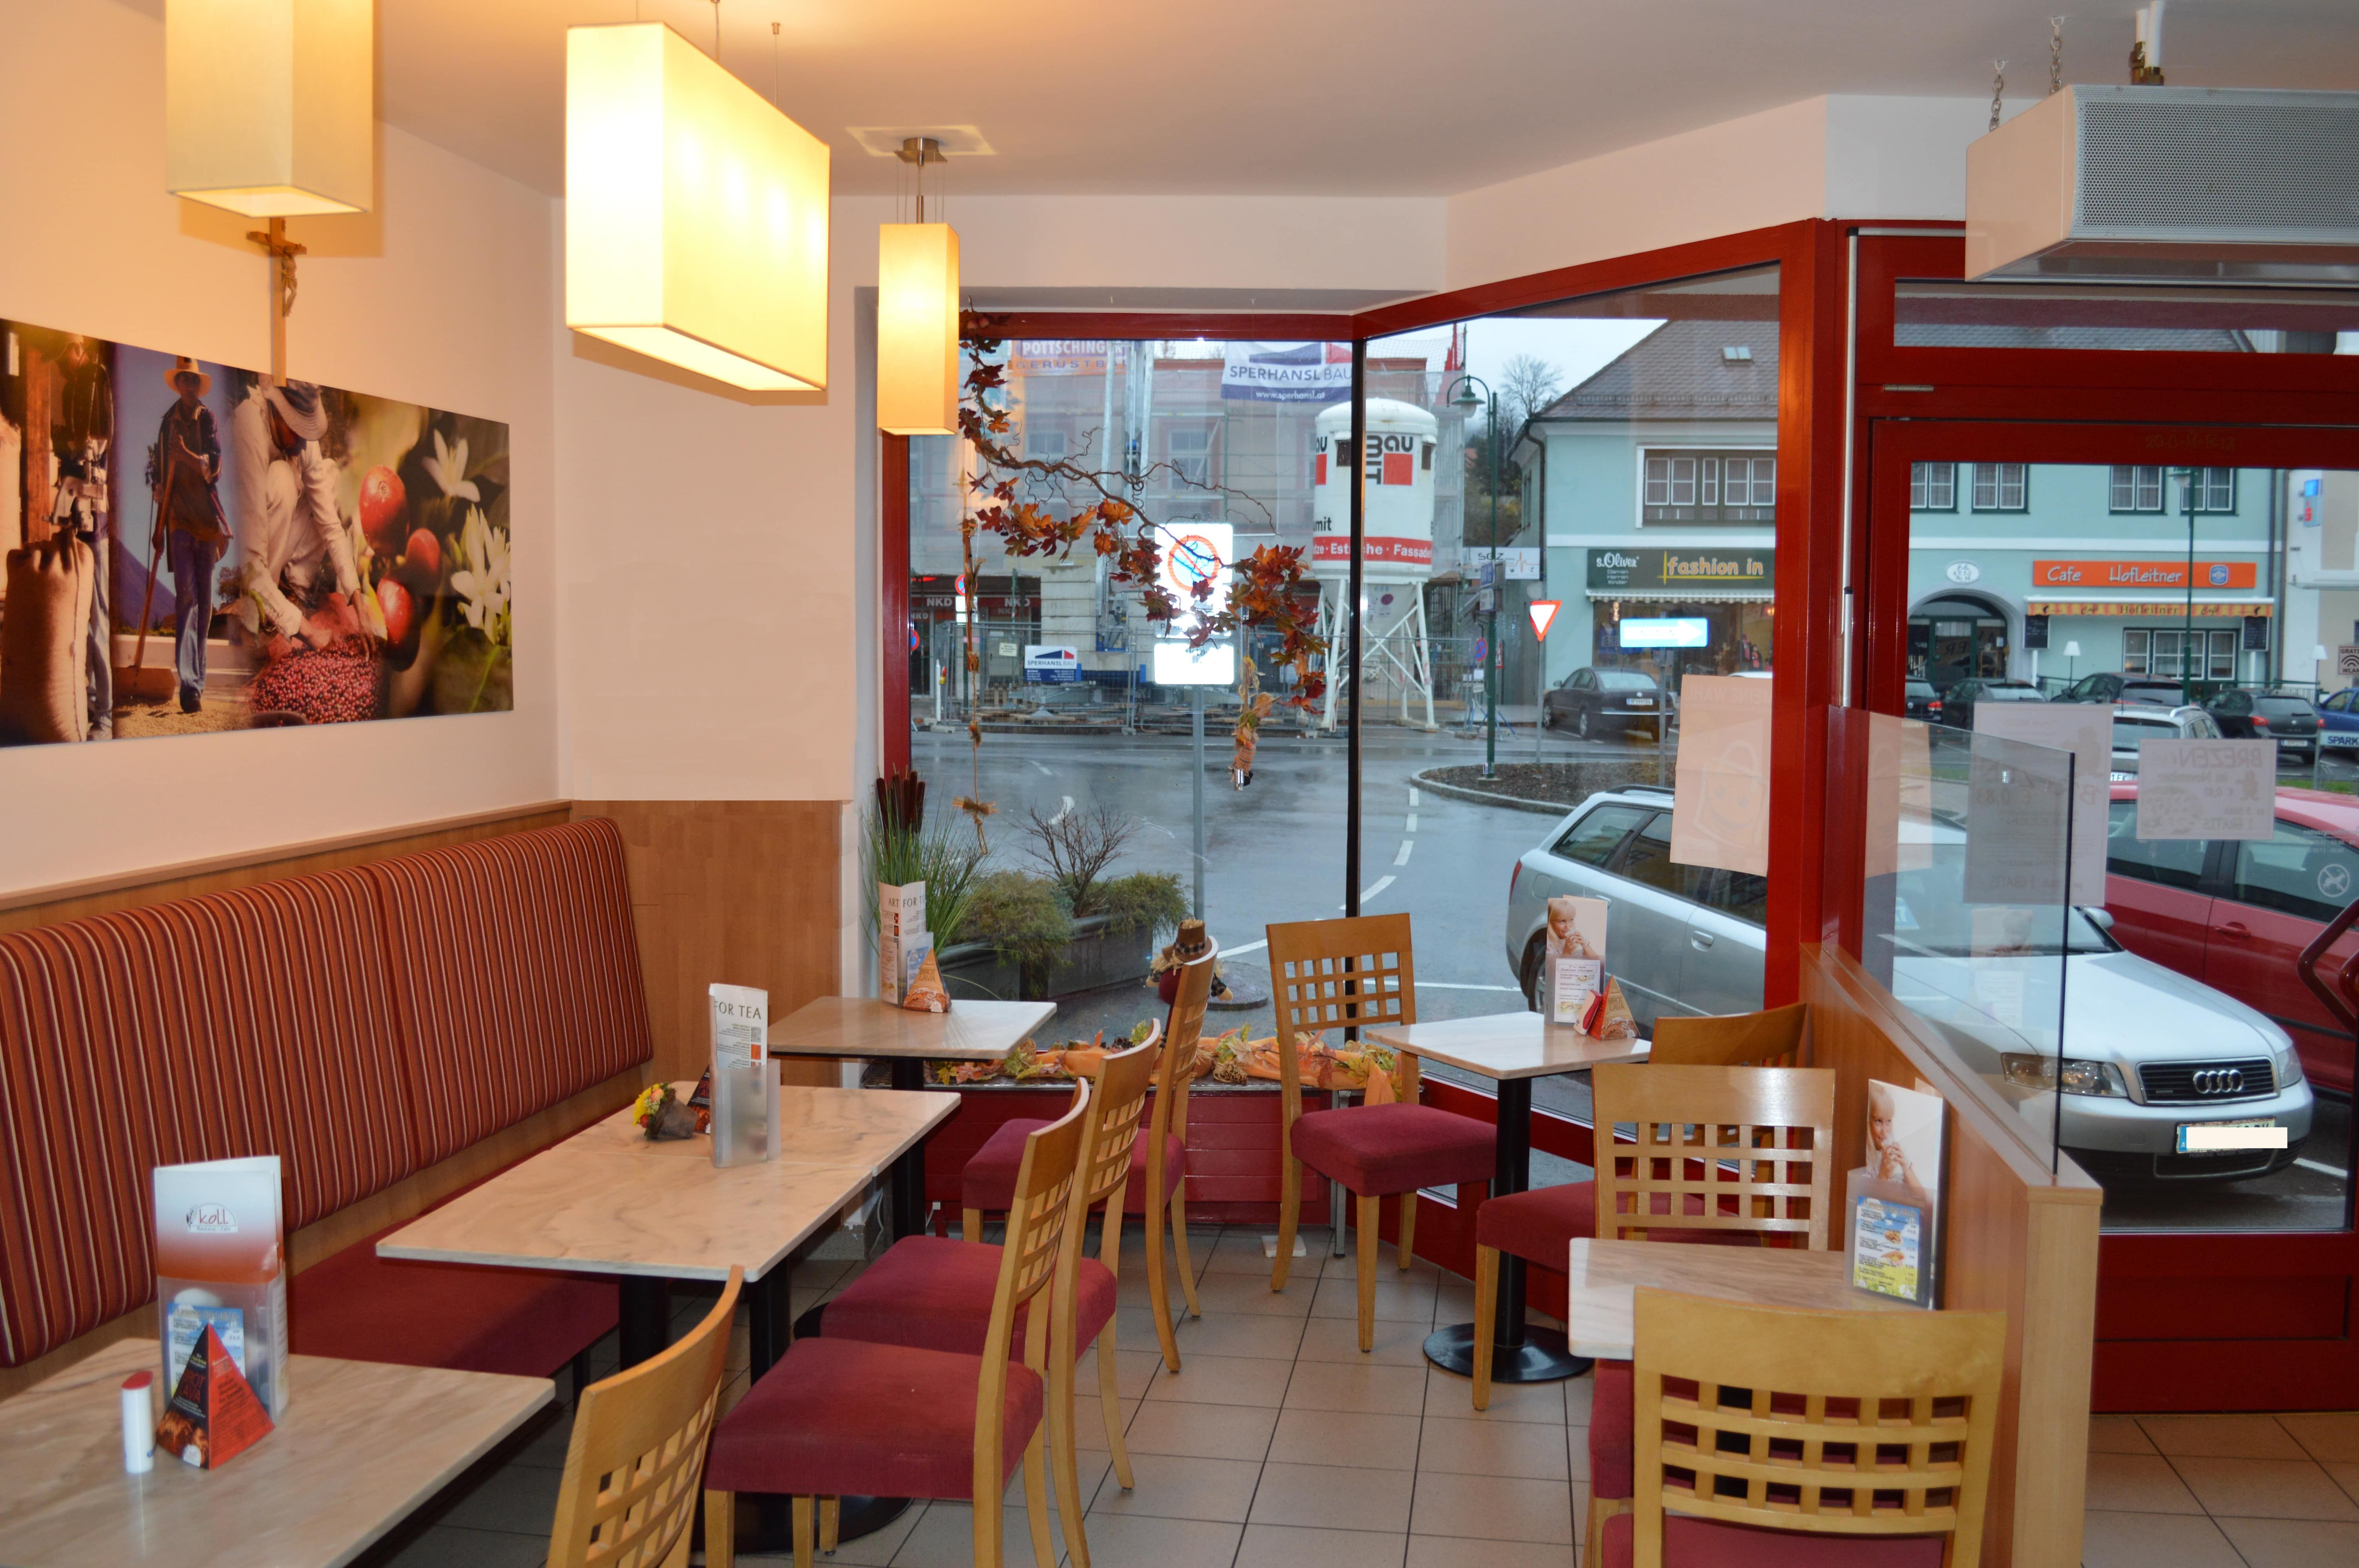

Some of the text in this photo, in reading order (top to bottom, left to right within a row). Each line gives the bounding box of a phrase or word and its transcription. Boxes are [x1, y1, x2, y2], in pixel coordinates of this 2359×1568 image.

[1230, 366, 1352, 381] SPERHANSL BAU
[1256, 391, 1325, 401] www.sperhansl.at
[1667, 557, 1763, 575] fashion in
[2047, 566, 2081, 582] Cafe
[927, 597, 953, 607] NKD
[2120, 605, 2179, 614] Hofleitner
[888, 899, 899, 908] ART
[903, 898, 917, 908] FOR
[739, 1005, 761, 1020] TEA
[1609, 1003, 1625, 1011] LAVA
[199, 1208, 229, 1225] koll
